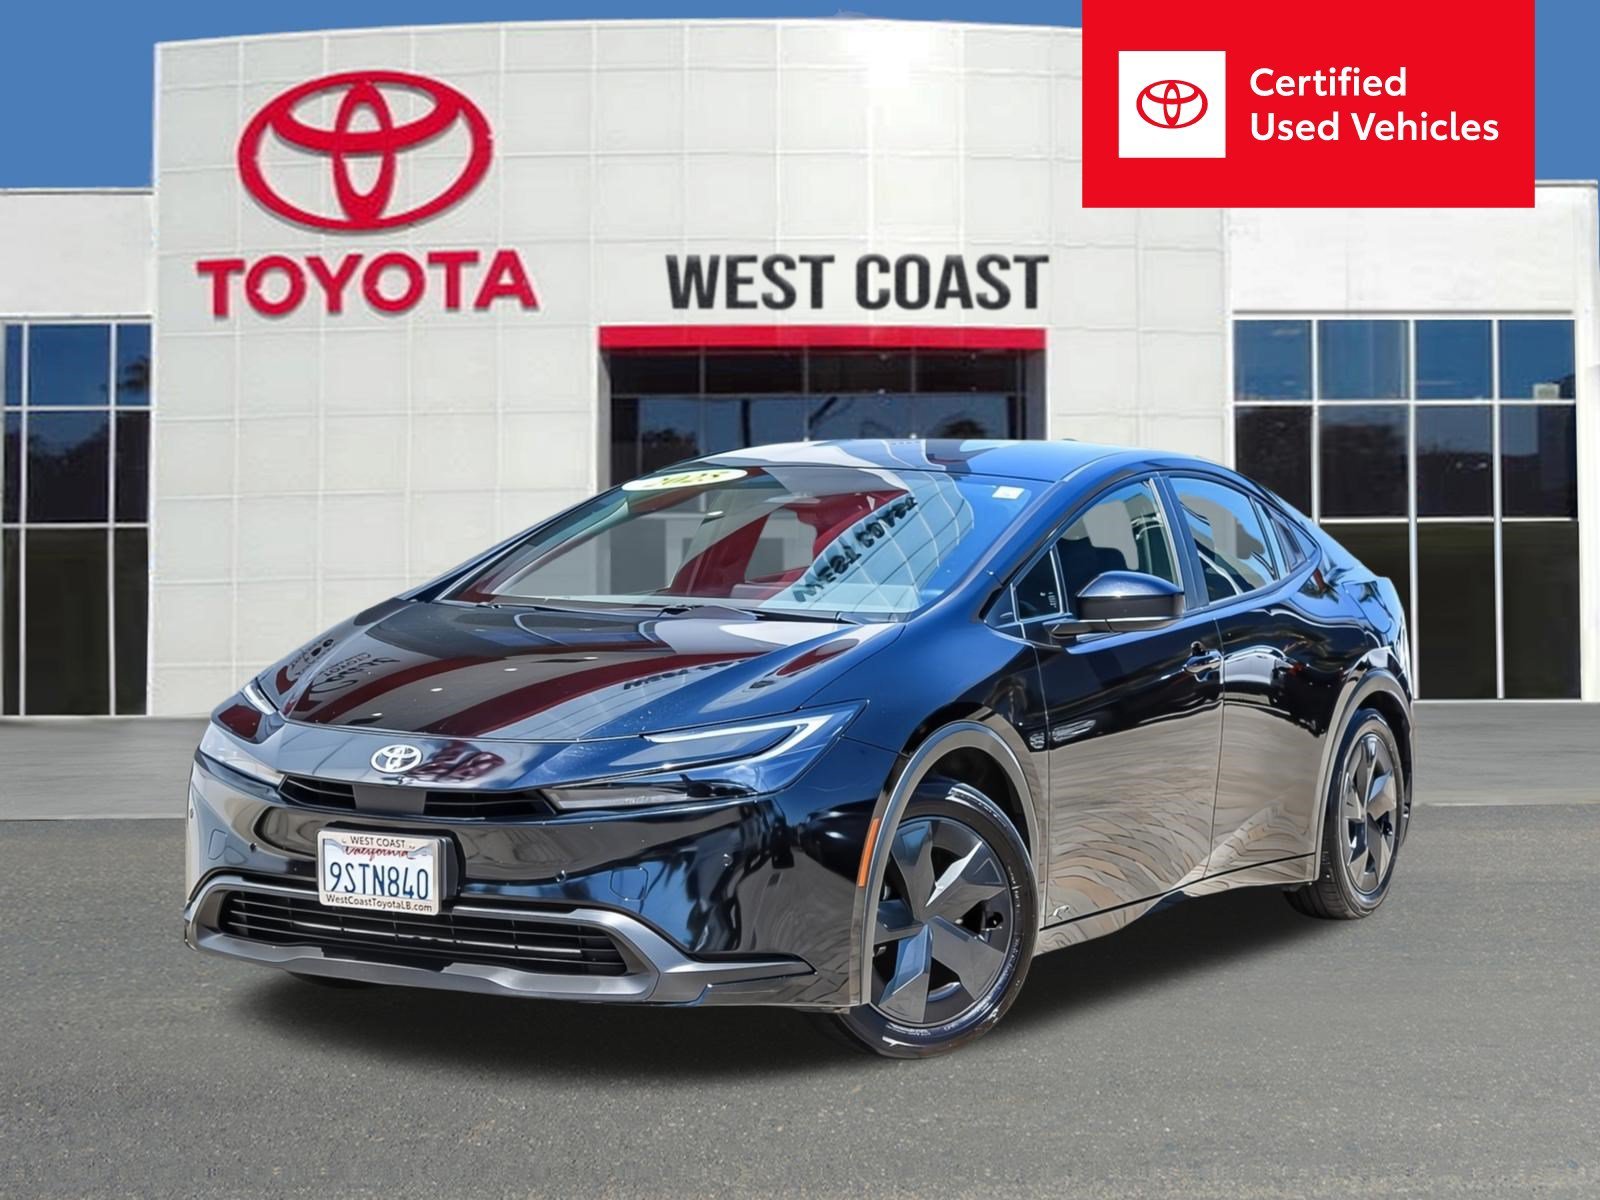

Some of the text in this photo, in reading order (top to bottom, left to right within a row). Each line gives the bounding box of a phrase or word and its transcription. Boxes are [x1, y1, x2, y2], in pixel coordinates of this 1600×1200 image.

[197, 250, 539, 318] TOYOTA
[666, 253, 1050, 310] WEST COAST
[350, 836, 405, 848] WEST COAST
[329, 861, 429, 899] 9STN840
[325, 894, 432, 912] WestCoastToyotaLB.com
